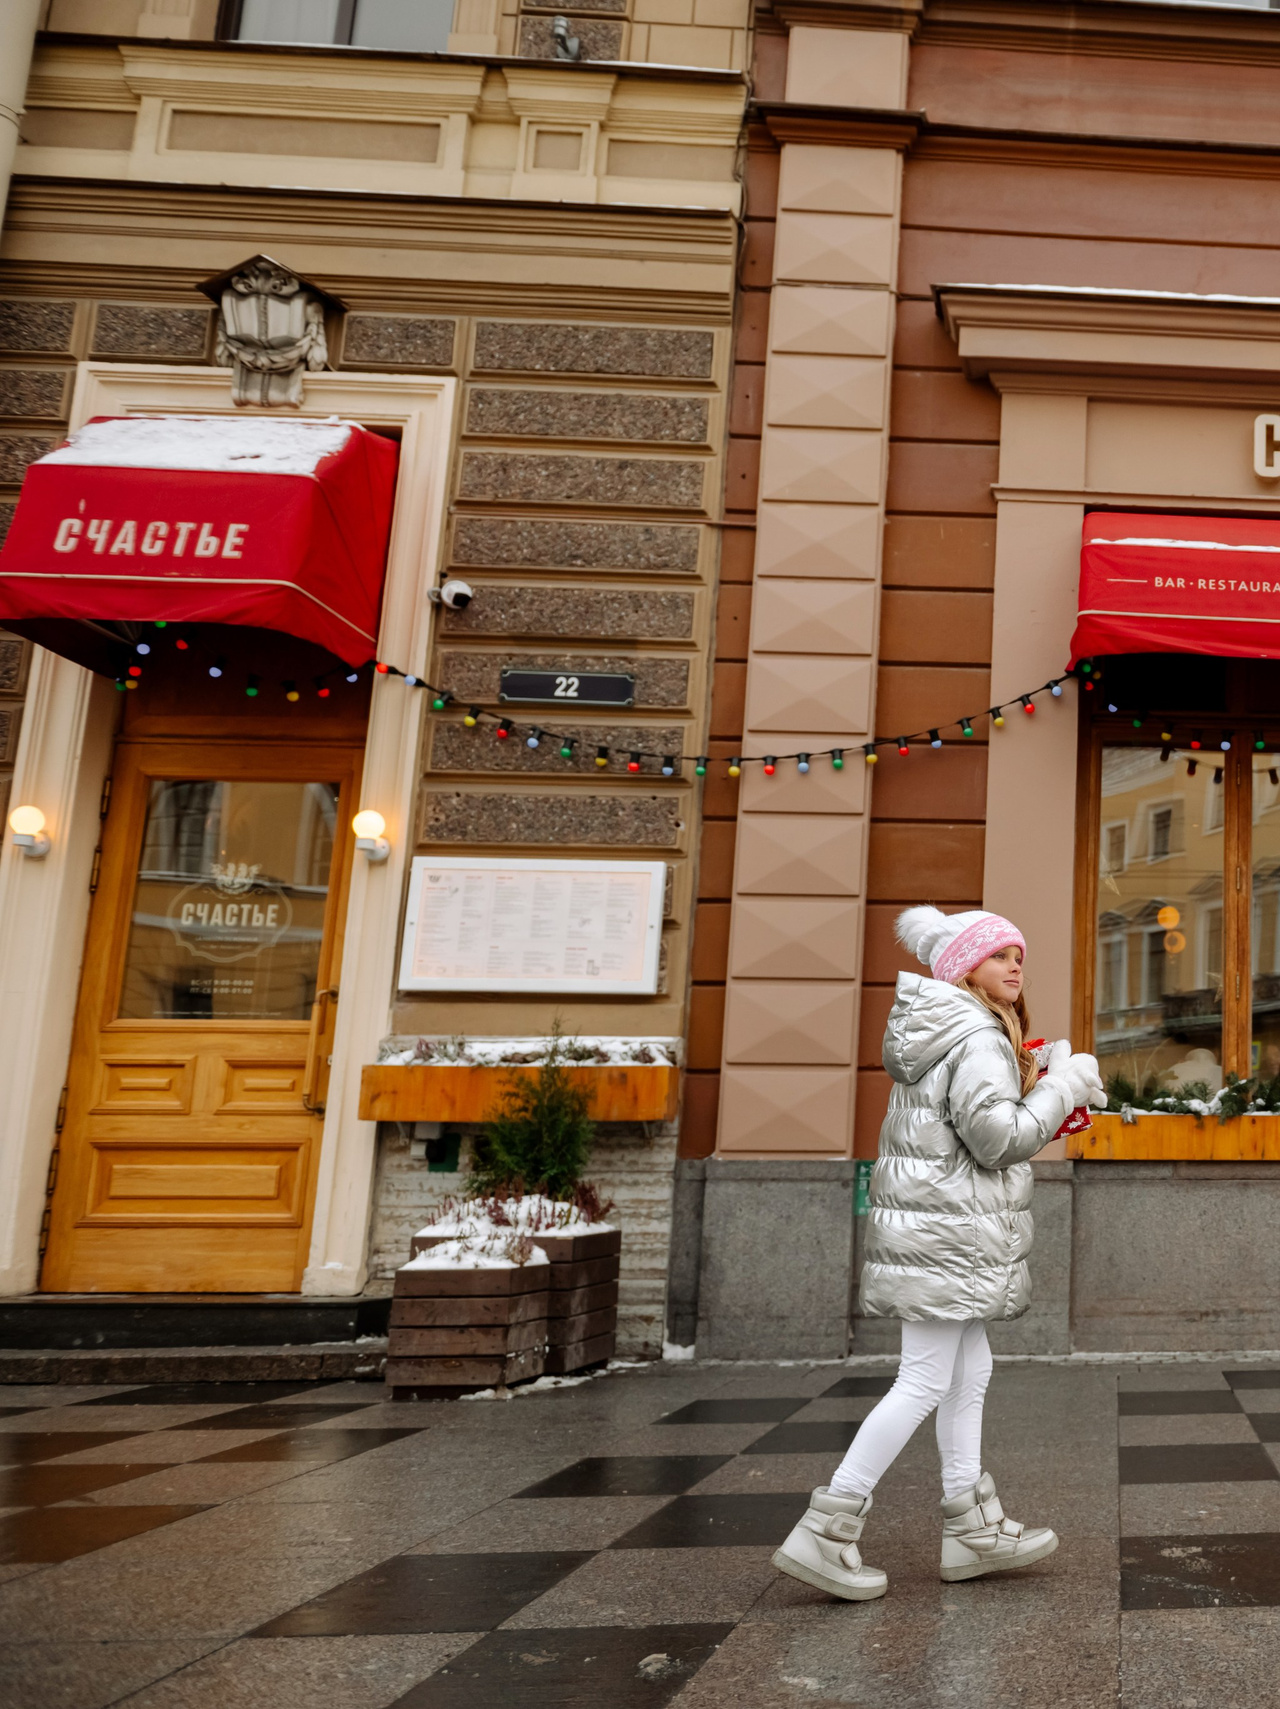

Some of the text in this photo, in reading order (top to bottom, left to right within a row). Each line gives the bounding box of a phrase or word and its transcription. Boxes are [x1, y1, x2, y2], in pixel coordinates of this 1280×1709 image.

[53, 517, 250, 559] СЧАСТЬЕ
[1154, 576, 1186, 589] BAR
[553, 676, 580, 698] 22
[180, 902, 279, 928] СЧАСТЬЕ
